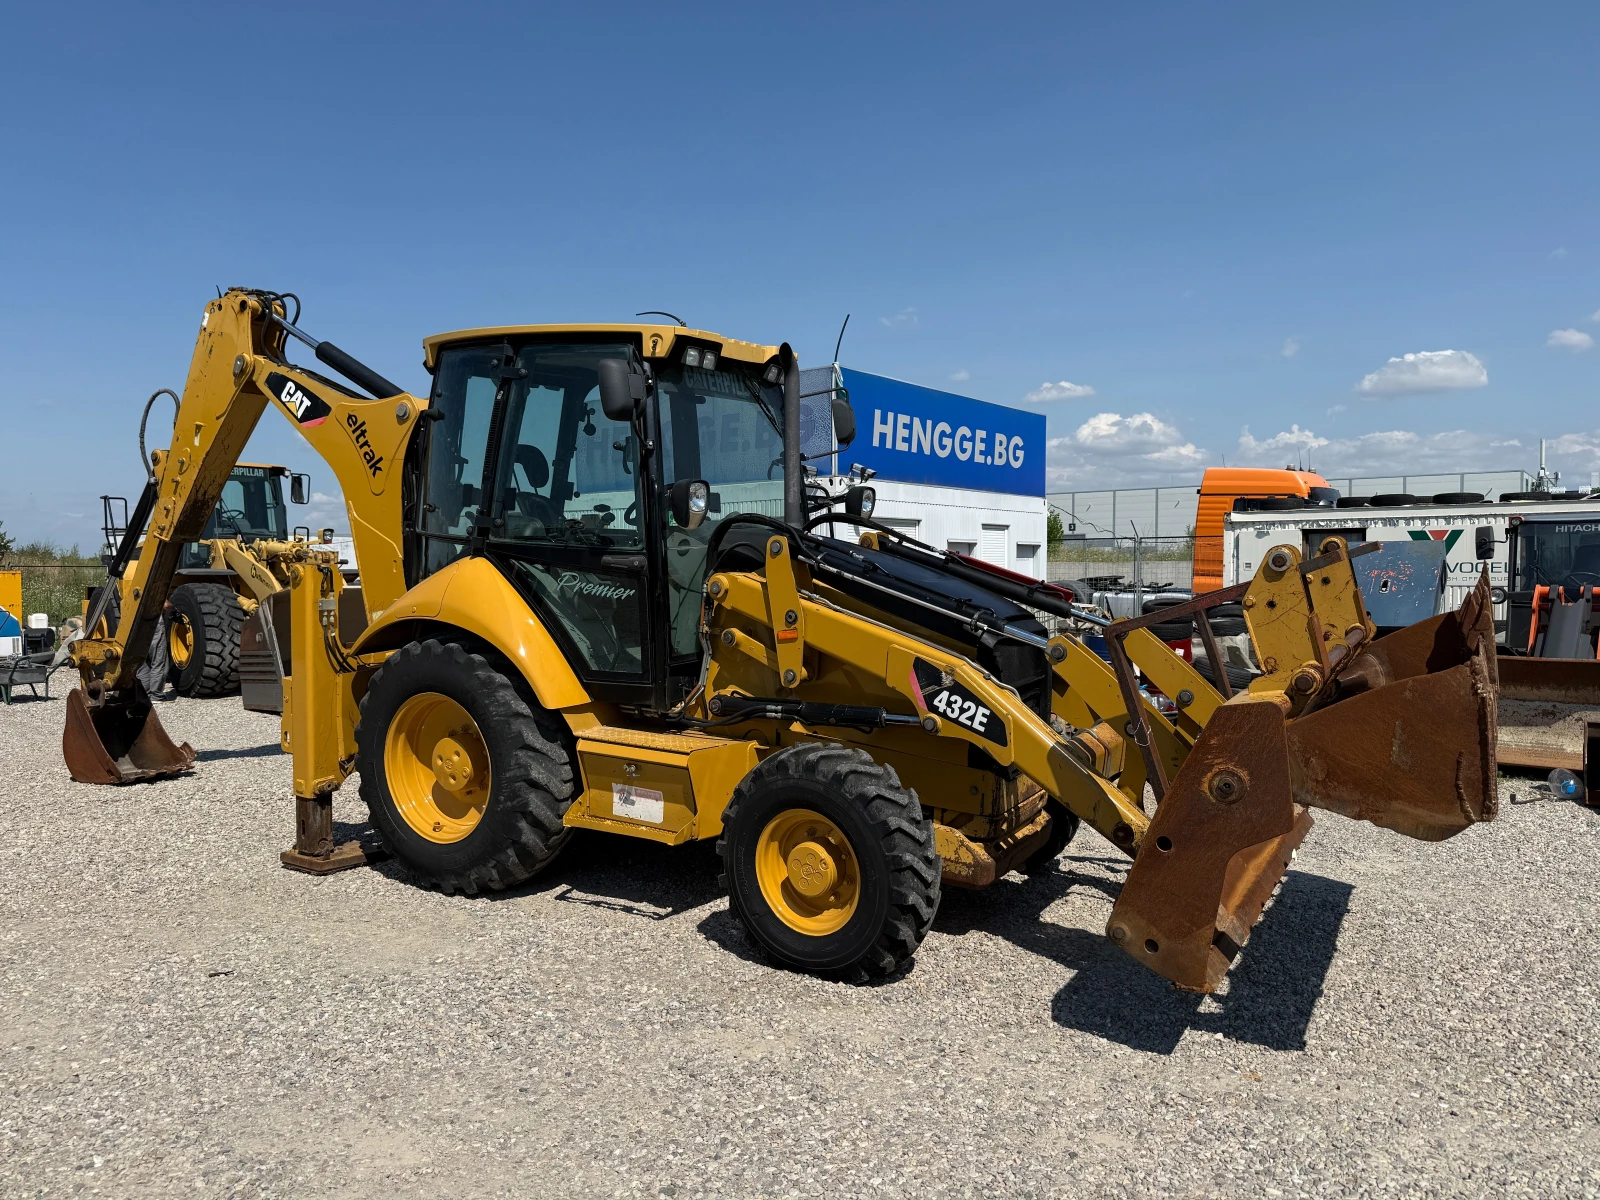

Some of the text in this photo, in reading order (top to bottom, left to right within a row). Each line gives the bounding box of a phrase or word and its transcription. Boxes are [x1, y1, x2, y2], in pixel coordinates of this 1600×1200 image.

[281, 381, 311, 418] CAT
[346, 413, 384, 478] eltrak
[872, 409, 1024, 469] HENGGE.BG
[557, 572, 636, 600] Premier
[933, 690, 990, 732] 432E
